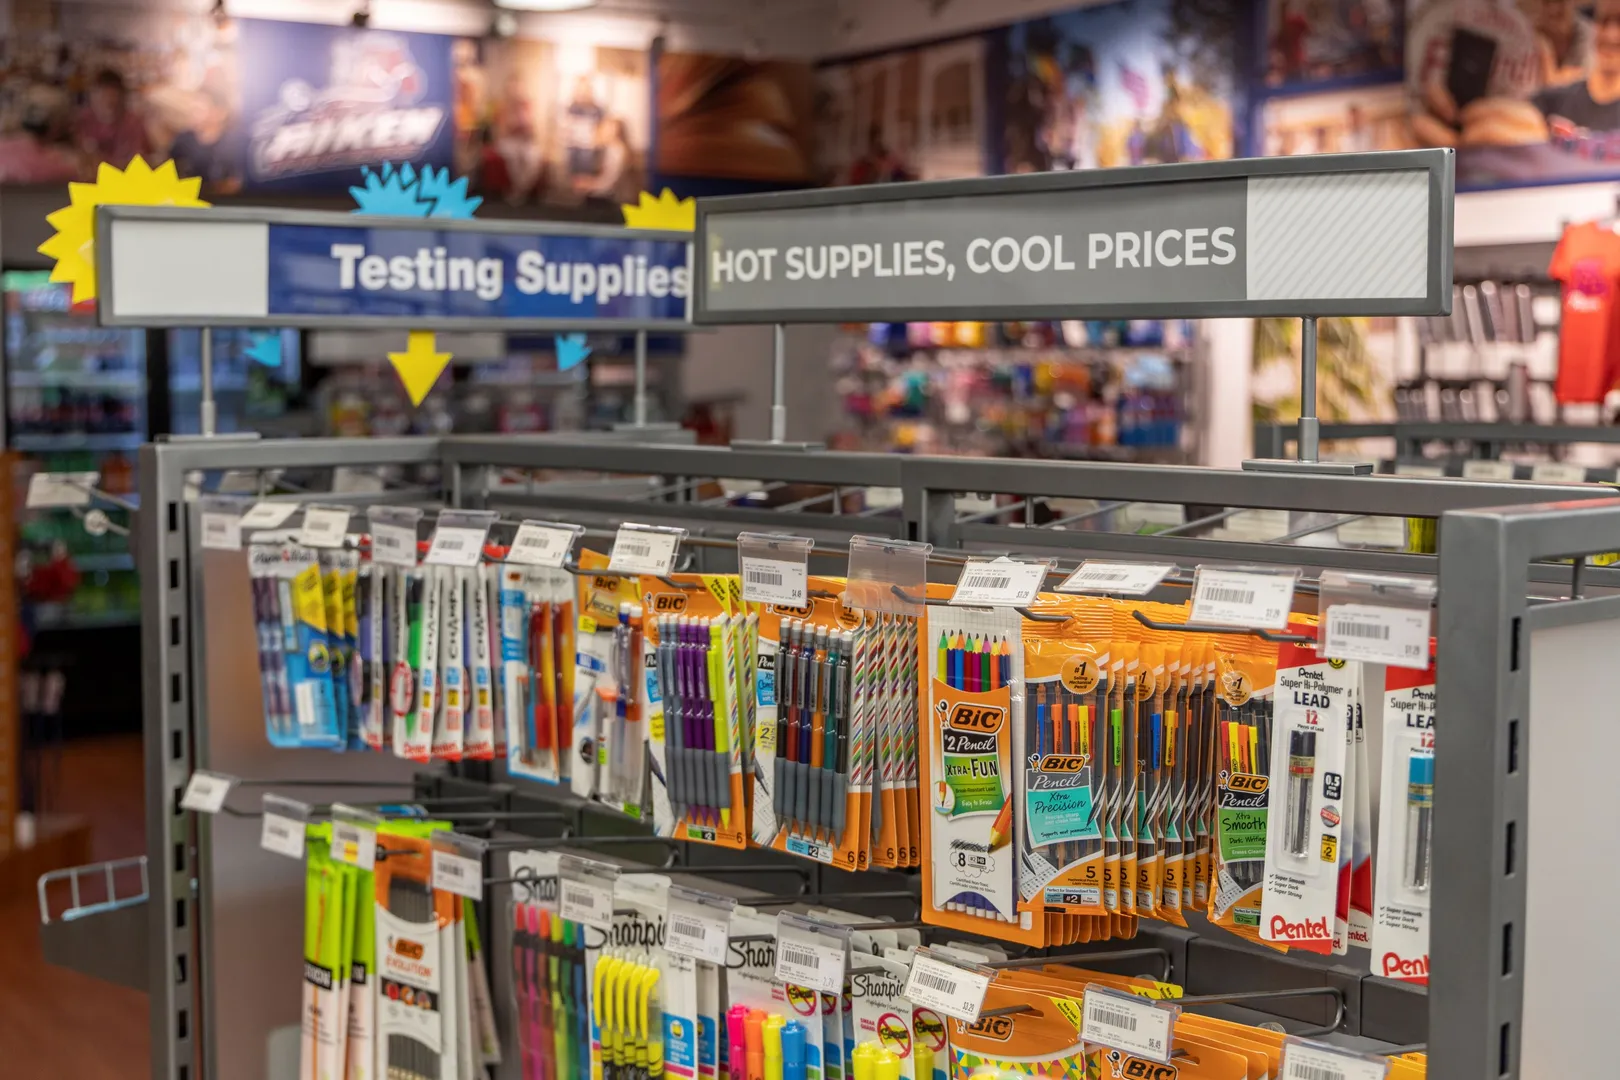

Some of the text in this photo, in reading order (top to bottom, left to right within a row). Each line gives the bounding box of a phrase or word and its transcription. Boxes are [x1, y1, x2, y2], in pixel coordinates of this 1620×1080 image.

[712, 226, 1237, 283] HOT SUPPLIES, COOL PRICES
[331, 243, 690, 304] Testing Supplies
[657, 596, 684, 610] BiC
[1074, 662, 1087, 676] #1
[1298, 667, 1324, 680] Pentel
[1280, 676, 1344, 696] Super Hi-Polymer
[1294, 691, 1330, 709] LEAD
[1391, 697, 1416, 712] Super
[954, 708, 1000, 729] BiC
[1306, 709, 1318, 726] 12
[956, 735, 995, 752] Pencil
[1044, 758, 1083, 770] BiC
[1033, 773, 1082, 791] Pencil
[1231, 776, 1266, 790] BiC
[1325, 774, 1340, 788] 0.5
[1049, 792, 1070, 802] Xtra
[1222, 793, 1265, 808] Pencil
[1035, 800, 1087, 814] Precision
[1236, 812, 1251, 820] Xtra
[1222, 818, 1266, 831] Smooth
[736, 832, 743, 843] 6
[848, 851, 855, 863] 6
[859, 851, 866, 862] 6
[886, 848, 894, 860] 6
[899, 847, 906, 859] 6
[910, 846, 917, 858] 6
[958, 852, 966, 867] 8
[1086, 866, 1096, 879] 5
[1104, 869, 1112, 881] 5
[1120, 868, 1128, 880] 5
[1140, 870, 1148, 882] 5
[1166, 869, 1174, 881] 5
[1274, 874, 1306, 886] Super Smooth
[1274, 880, 1287, 889] Super
[1066, 894, 1078, 904] #2
[1274, 888, 1302, 900] Super Strong
[1270, 914, 1330, 939] Pentel
[1402, 924, 1419, 932] Strong
[962, 1001, 975, 1012] $3.29
